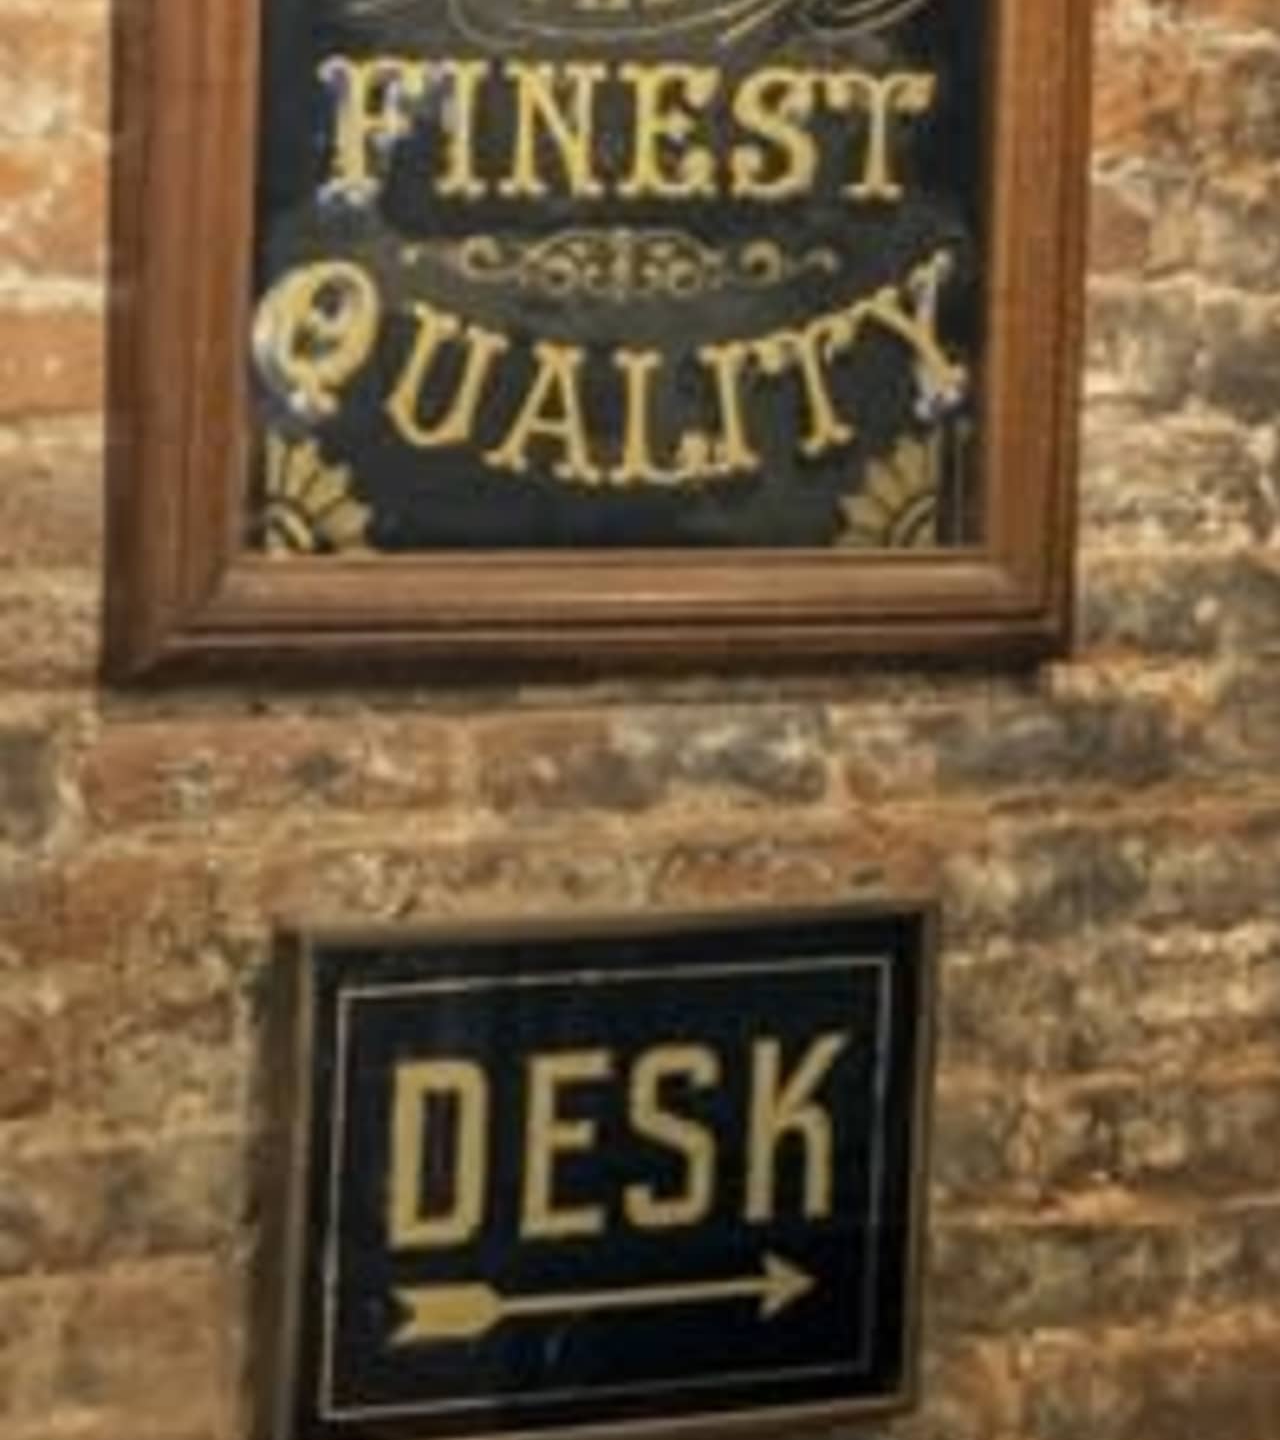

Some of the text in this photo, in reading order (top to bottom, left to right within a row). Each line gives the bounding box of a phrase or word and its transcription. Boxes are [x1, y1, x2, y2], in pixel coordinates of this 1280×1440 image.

[317, 59, 936, 206] FINEST
[253, 251, 970, 486] QUALITY
[385, 1028, 850, 1253] DESK
